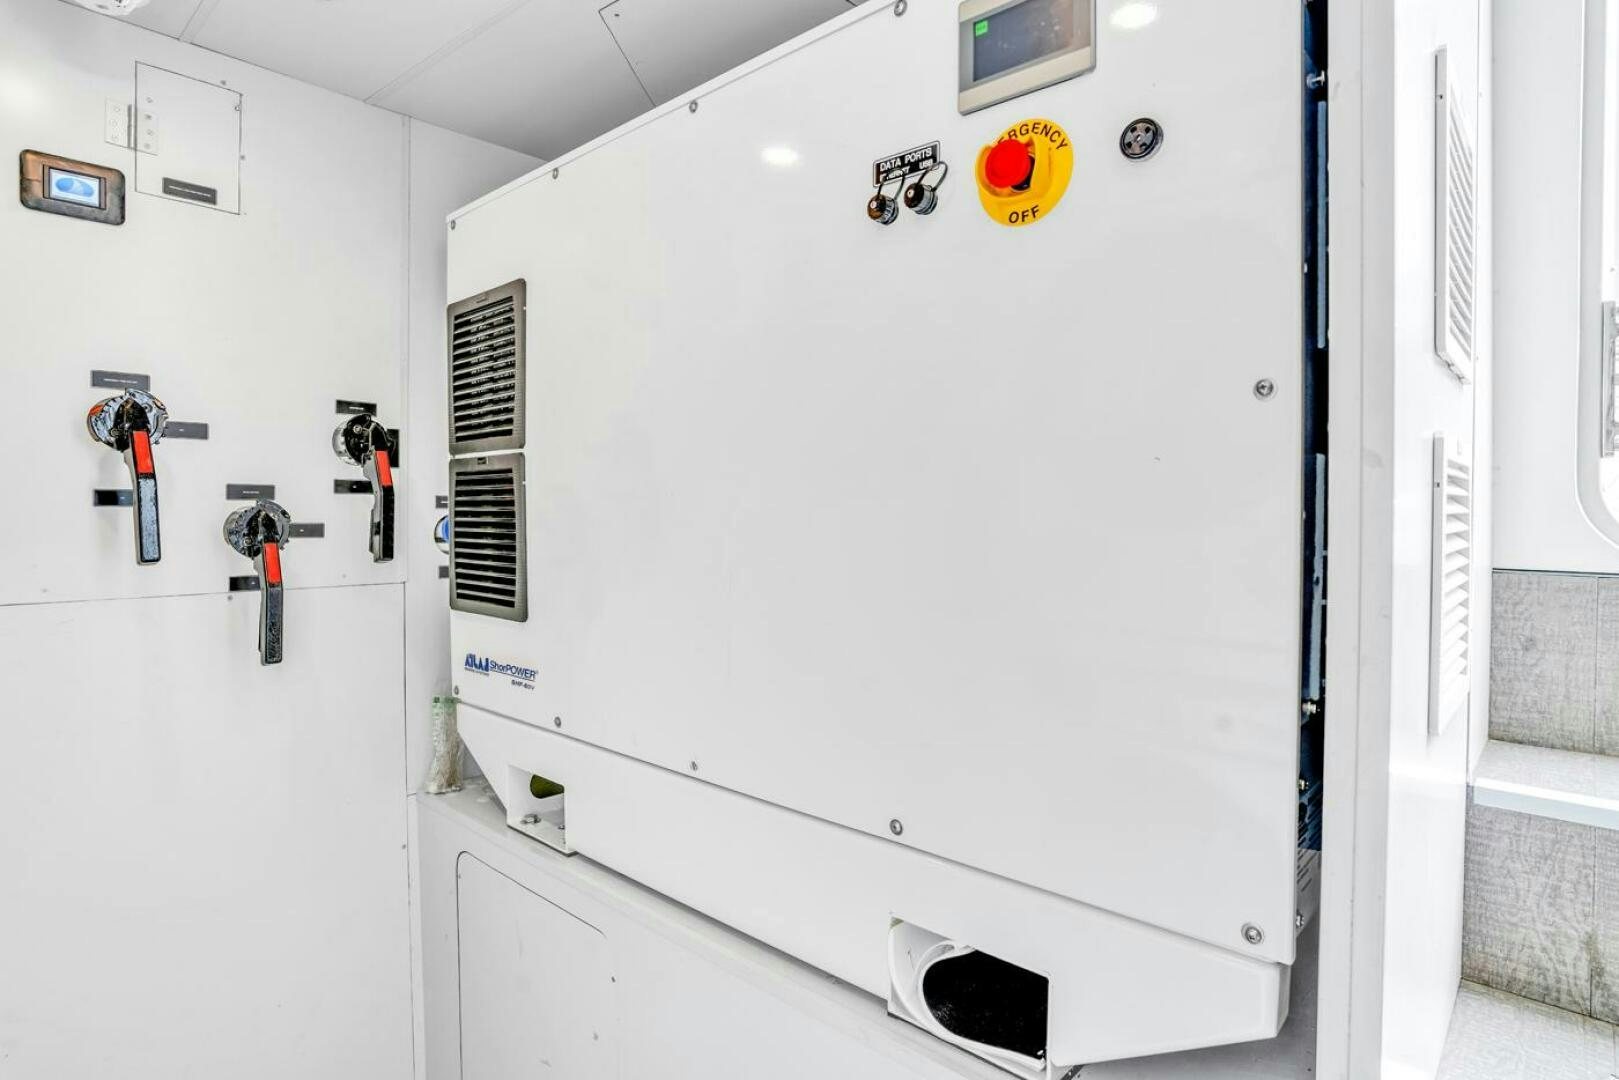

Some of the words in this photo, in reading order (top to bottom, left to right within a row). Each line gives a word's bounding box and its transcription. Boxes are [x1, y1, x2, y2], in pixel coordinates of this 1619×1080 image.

[879, 157, 902, 171] DATA
[904, 147, 932, 164] PORTS
[1008, 205, 1040, 224] OFF
